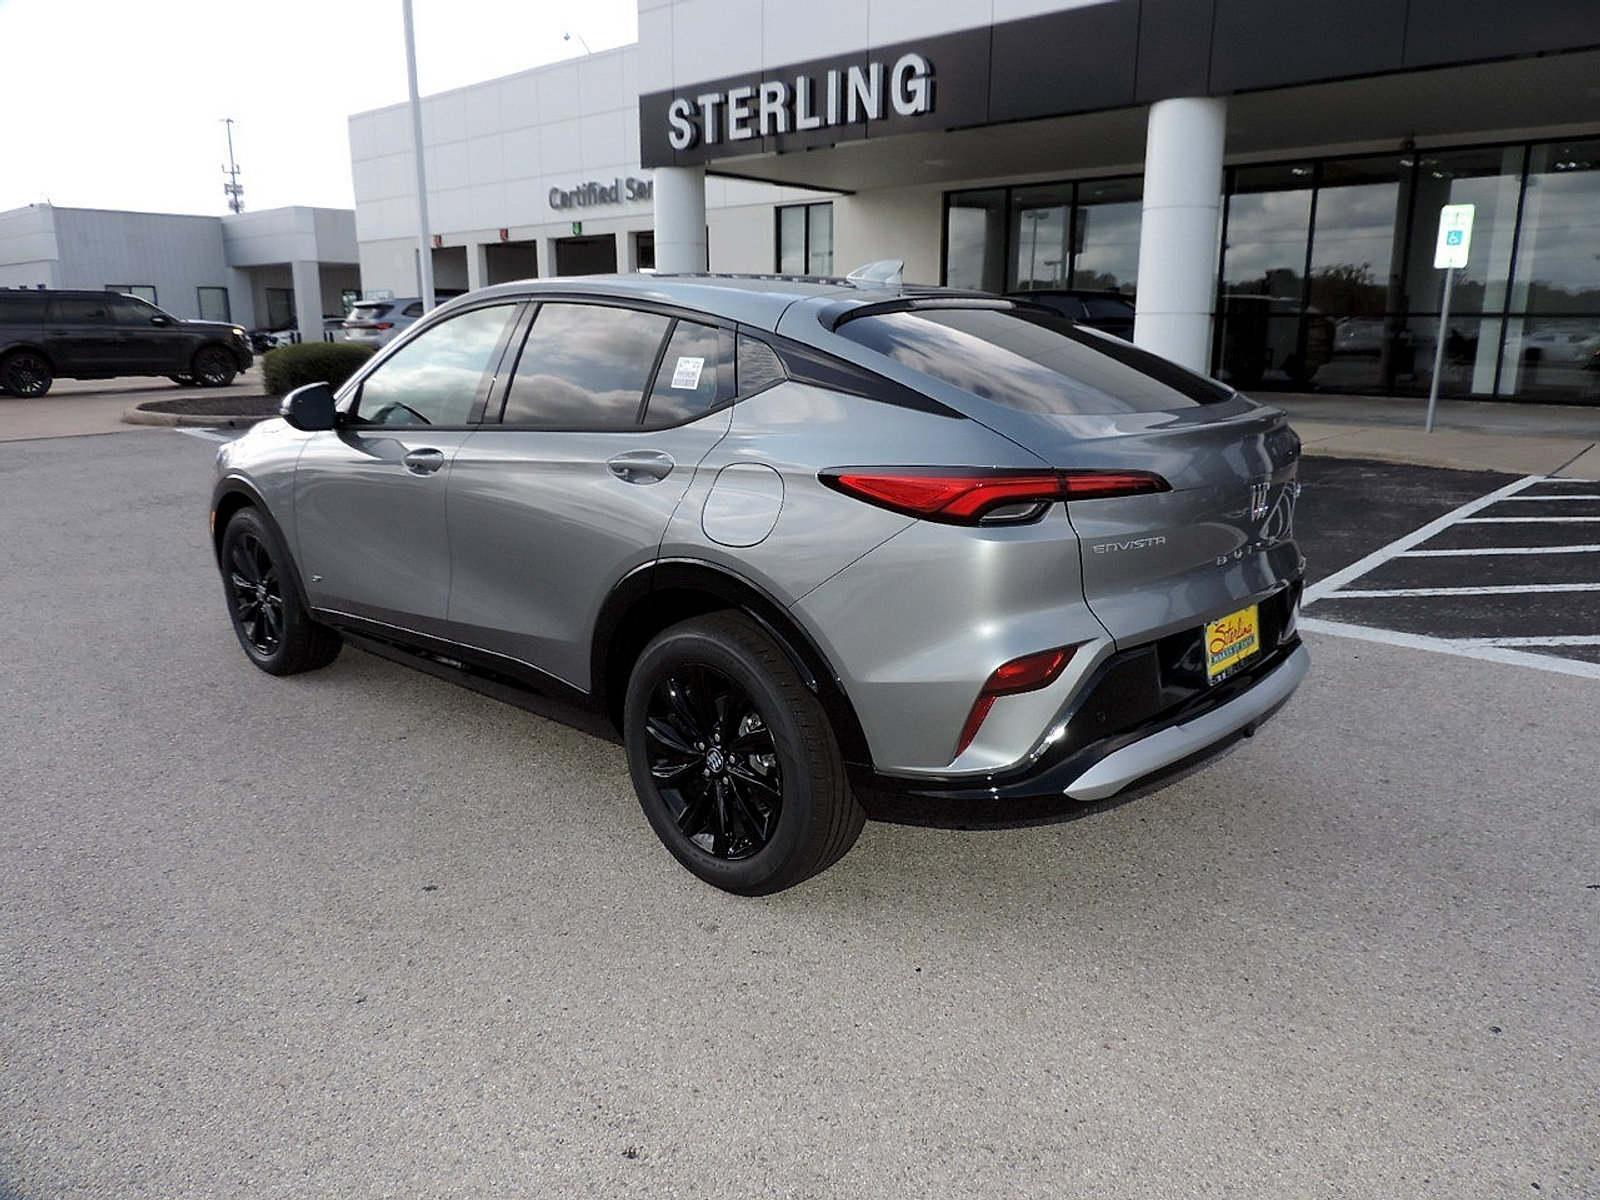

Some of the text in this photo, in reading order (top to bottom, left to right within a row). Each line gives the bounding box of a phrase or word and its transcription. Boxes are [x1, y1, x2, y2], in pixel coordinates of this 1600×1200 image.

[668, 53, 932, 150] STERLING
[548, 178, 620, 210] Certified
[1093, 536, 1166, 554] ENVISTA
